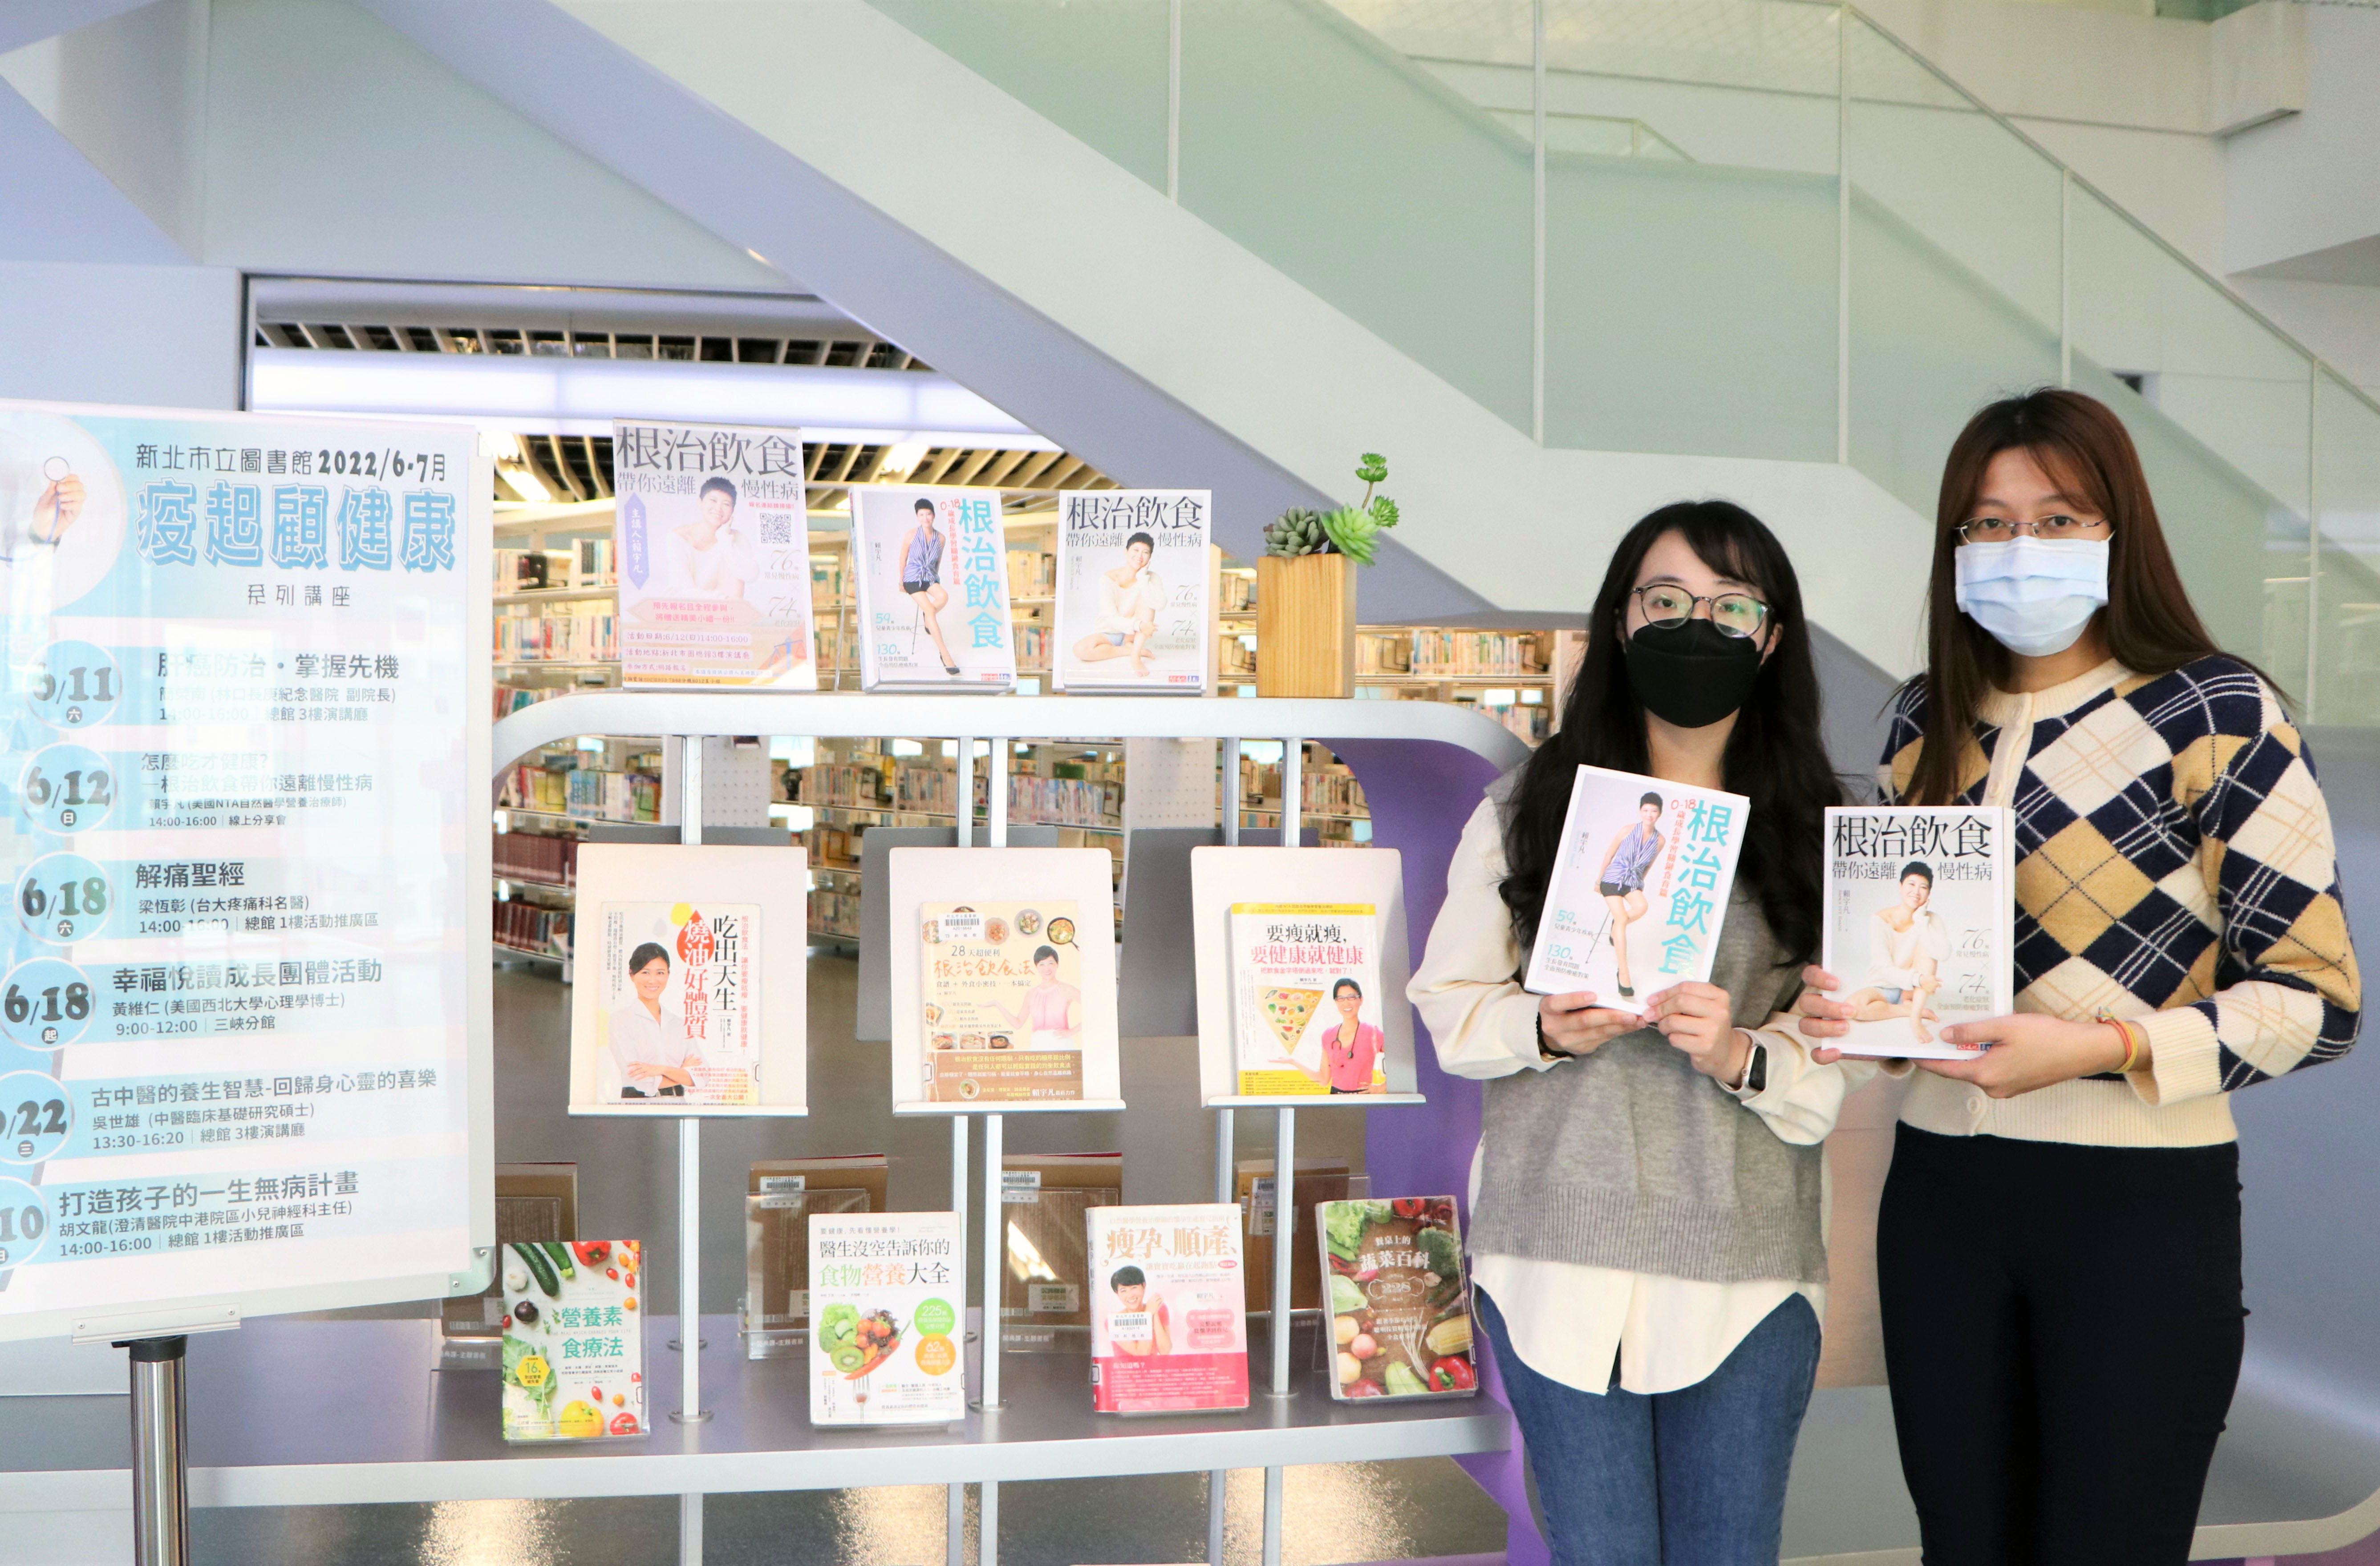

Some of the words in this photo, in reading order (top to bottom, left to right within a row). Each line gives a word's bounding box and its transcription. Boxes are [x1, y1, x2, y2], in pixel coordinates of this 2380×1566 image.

[616, 427, 797, 477] 根治飲食
[616, 472, 696, 495] 帶你遠離
[742, 478, 799, 501] 慢性病
[135, 477, 456, 572] 疫起顧健康
[1067, 497, 1203, 530] 根治飲食
[1066, 533, 1123, 548] 帶你遠離
[1158, 532, 1202, 547] 慢性病
[959, 498, 1004, 648] 根治飲食
[247, 583, 350, 607] 系列講座
[346, 687, 396, 704] 副院長)
[69, 708, 81, 720] 六
[265, 706, 295, 722] 總館
[299, 706, 369, 722] 3樓演講廳
[26, 765, 112, 809] 6/12
[1670, 799, 1696, 810] 0-18
[64, 813, 74, 824] 日
[150, 816, 216, 827] 14:00-16:00
[228, 814, 287, 826] 線上分享會
[1833, 815, 1992, 858] 根治飲食
[136, 862, 245, 888] 解痛聖經
[1833, 861, 1897, 880] 帶你遠離
[1938, 862, 1992, 881] 慢性病
[23, 877, 107, 920] 6/18
[1658, 800, 1732, 979] 根治飲食
[139, 898, 186, 915] 梁恆彰
[190, 895, 309, 914] (台大疼痛科名醫)
[60, 922, 71, 934] 六
[138, 918, 229, 934] 14:00-16:00
[245, 916, 275, 931] 總館
[280, 912, 379, 930] 1樓活動推廣區
[713, 915, 738, 1012] 吃出天生
[952, 946, 965, 957] 28
[1250, 946, 1364, 965] 要健康就健康
[112, 957, 383, 995] 幸福悅讀成長團體活動
[684, 919, 711, 1040] 燒油好體質
[934, 959, 1035, 978] 根治飲食法
[4, 981, 90, 1025] 6/18
[113, 999, 159, 1017] 黃維仁
[164, 993, 345, 1016] (美國西北大學心理學博士)
[44, 1028, 57, 1041] 起
[115, 1019, 198, 1036] 9:00-12:00
[214, 1014, 276, 1032] 三峽分館
[92, 1068, 438, 1108] 古中醫的養生智慧-回歸身心靈的喜樂
[93, 1114, 141, 1131] 吳世雄
[148, 1103, 315, 1129] (中醫臨床基礎研究碩士)
[93, 1130, 184, 1150] 13:30-16:20
[200, 1126, 231, 1142] 總館
[235, 1121, 306, 1141] 3樓演講廳
[20, 1143, 32, 1156] 三
[59, 1170, 360, 1217] 打造孩子的一生無病計畫
[59, 1237, 152, 1258] 14:00-16:00
[168, 1231, 200, 1249] 總館
[203, 1222, 305, 1246] 1樓活動推廣區
[820, 1238, 949, 1258] 醫生沒空告訴你的
[1107, 1226, 1237, 1259] 瘦孕、順產、
[1358, 1250, 1430, 1272] 蔬菜百科
[820, 1262, 949, 1287] 食物營養大全
[1381, 1282, 1411, 1294] 228
[562, 1306, 623, 1328] 營養素
[562, 1336, 623, 1359] 食療法
